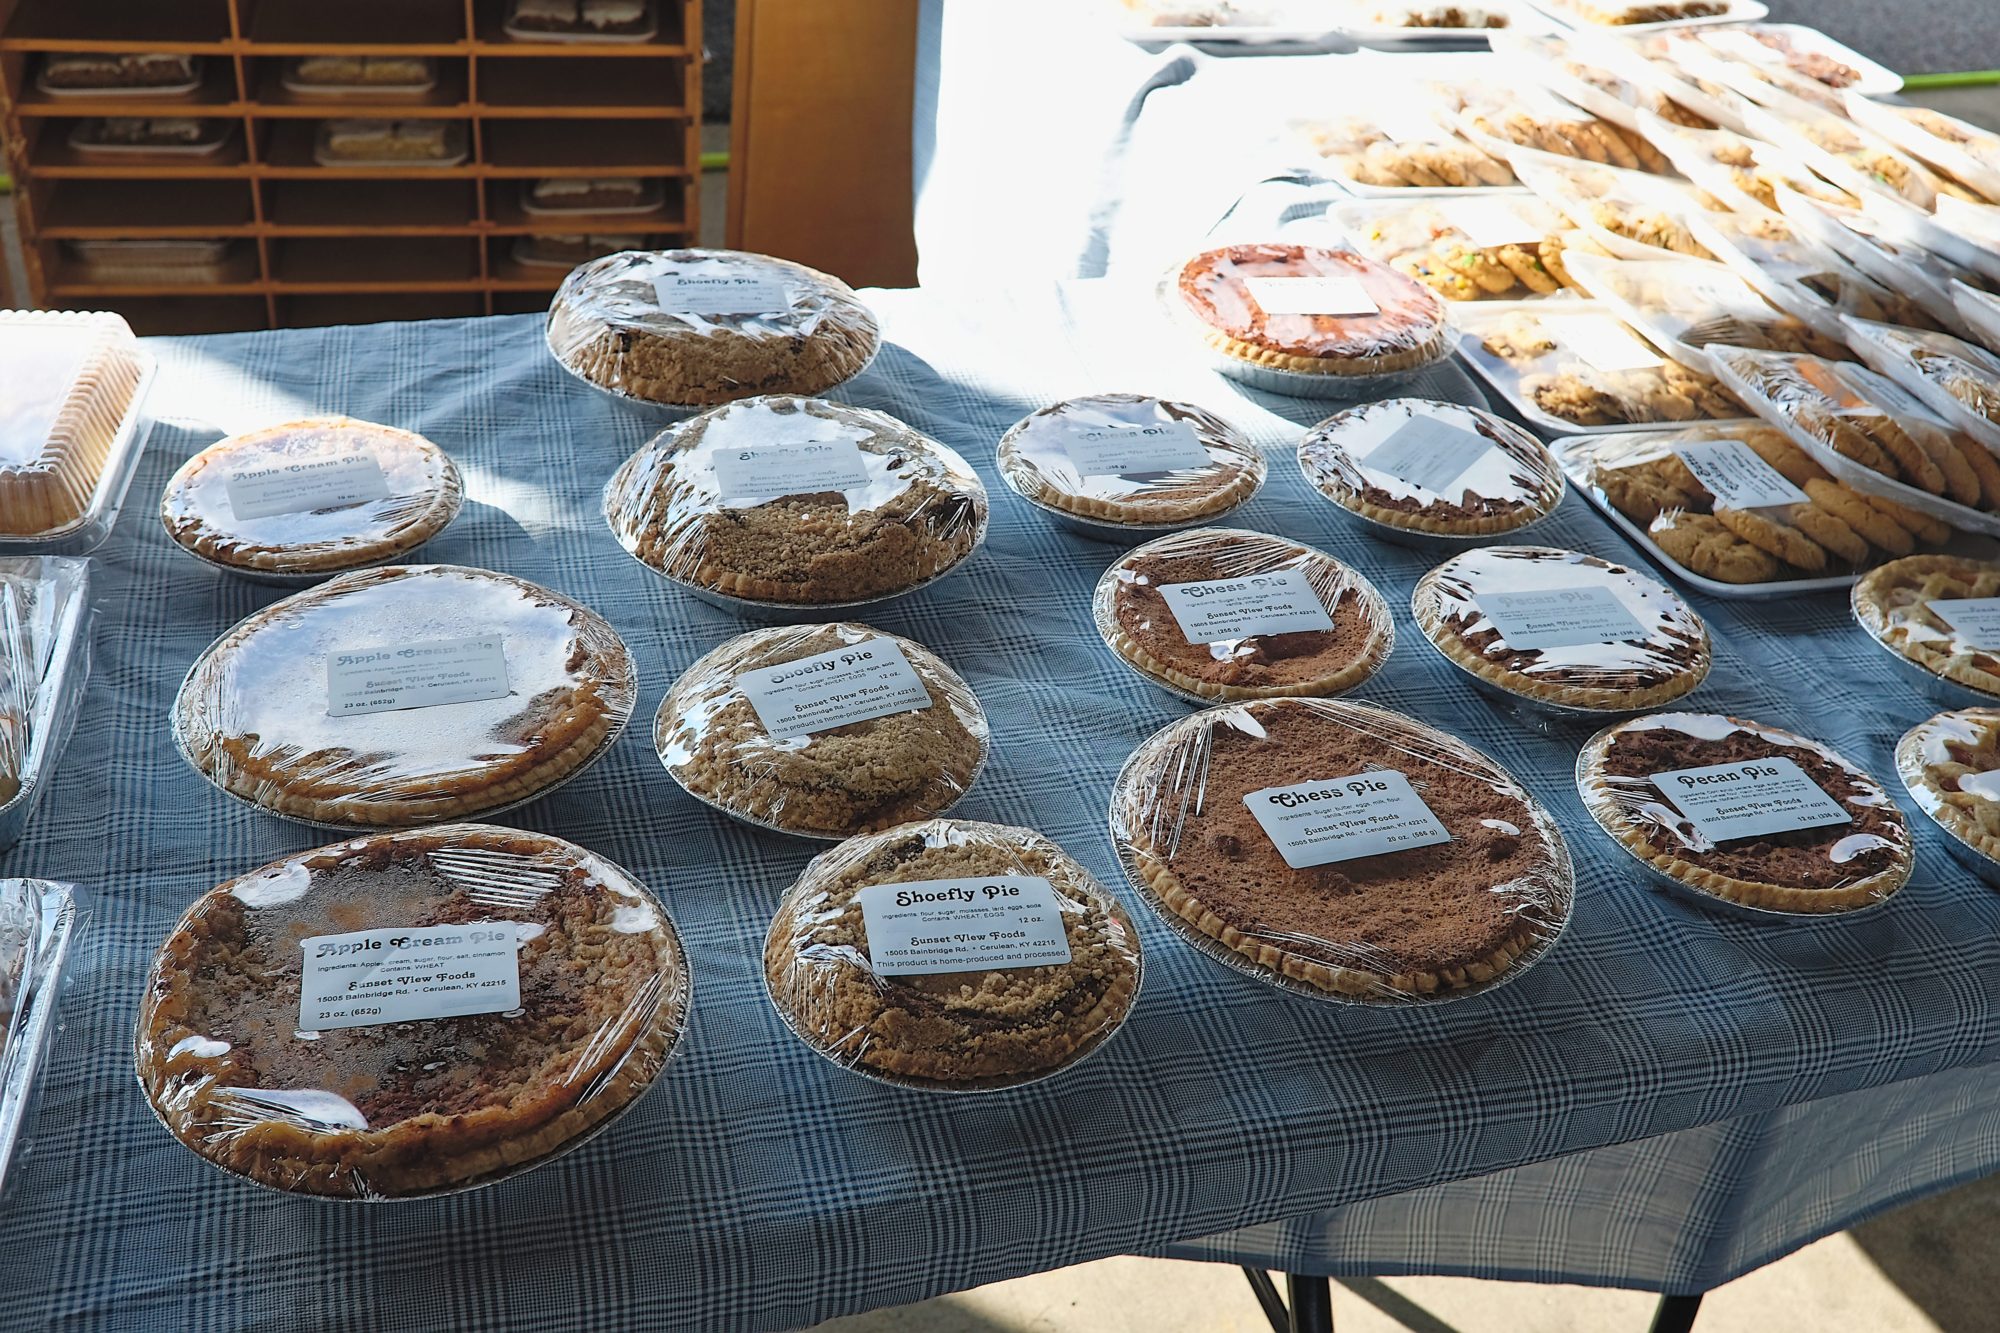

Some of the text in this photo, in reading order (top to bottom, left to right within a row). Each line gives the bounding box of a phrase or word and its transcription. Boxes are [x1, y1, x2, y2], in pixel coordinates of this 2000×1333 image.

[233, 468, 280, 482] Apple
[284, 460, 337, 473] Cream
[342, 455, 369, 465] Pie
[1181, 577, 1287, 597] Chess Pie
[1498, 591, 1594, 608] Pecan Pie
[1207, 611, 1237, 620] Sunset
[1265, 604, 1293, 612] Foods
[1209, 618, 1241, 626] Bainbridge
[336, 652, 391, 667] Apple
[397, 648, 457, 659] Cream
[769, 651, 873, 684] Shoefly Pie
[366, 671, 471, 688] Sunset View Foods
[364, 686, 403, 695] Bainbridge
[794, 684, 890, 712] Sunset View Foods
[776, 715, 797, 724] 15005
[797, 708, 834, 720] Bainbridge
[854, 696, 886, 706] Cerulean,
[897, 687, 917, 695] 42215
[789, 720, 816, 731] product
[824, 706, 878, 722] home-produced
[1677, 765, 1779, 789] Pecan Pie
[1269, 780, 1388, 808] Chess Pie
[1716, 798, 1802, 815] Sunset View Foods
[1721, 812, 1753, 820] Bainbridge
[1288, 839, 1308, 847] 15005
[1309, 833, 1345, 844] Bainbridge
[1365, 824, 1397, 833] Cerulean,
[1408, 818, 1428, 826] 42215
[1304, 813, 1399, 835] Sunset View Foods
[896, 884, 1020, 907] Shoefly Pie
[316, 930, 505, 958] Apple Cream Pie
[910, 930, 1026, 946] Sunset View Foods
[473, 950, 505, 958] cinnamon
[910, 946, 953, 955] Bainbridge
[980, 942, 1018, 951] Cerulean,
[897, 958, 928, 967] product
[940, 953, 1004, 965] home-produced
[348, 971, 476, 991] Sunset View Foods
[318, 995, 343, 1003] 15005
[346, 989, 393, 1001] Bainbridge
[423, 984, 464, 993] Cerulean,
[350, 1007, 382, 1016] (652g)
